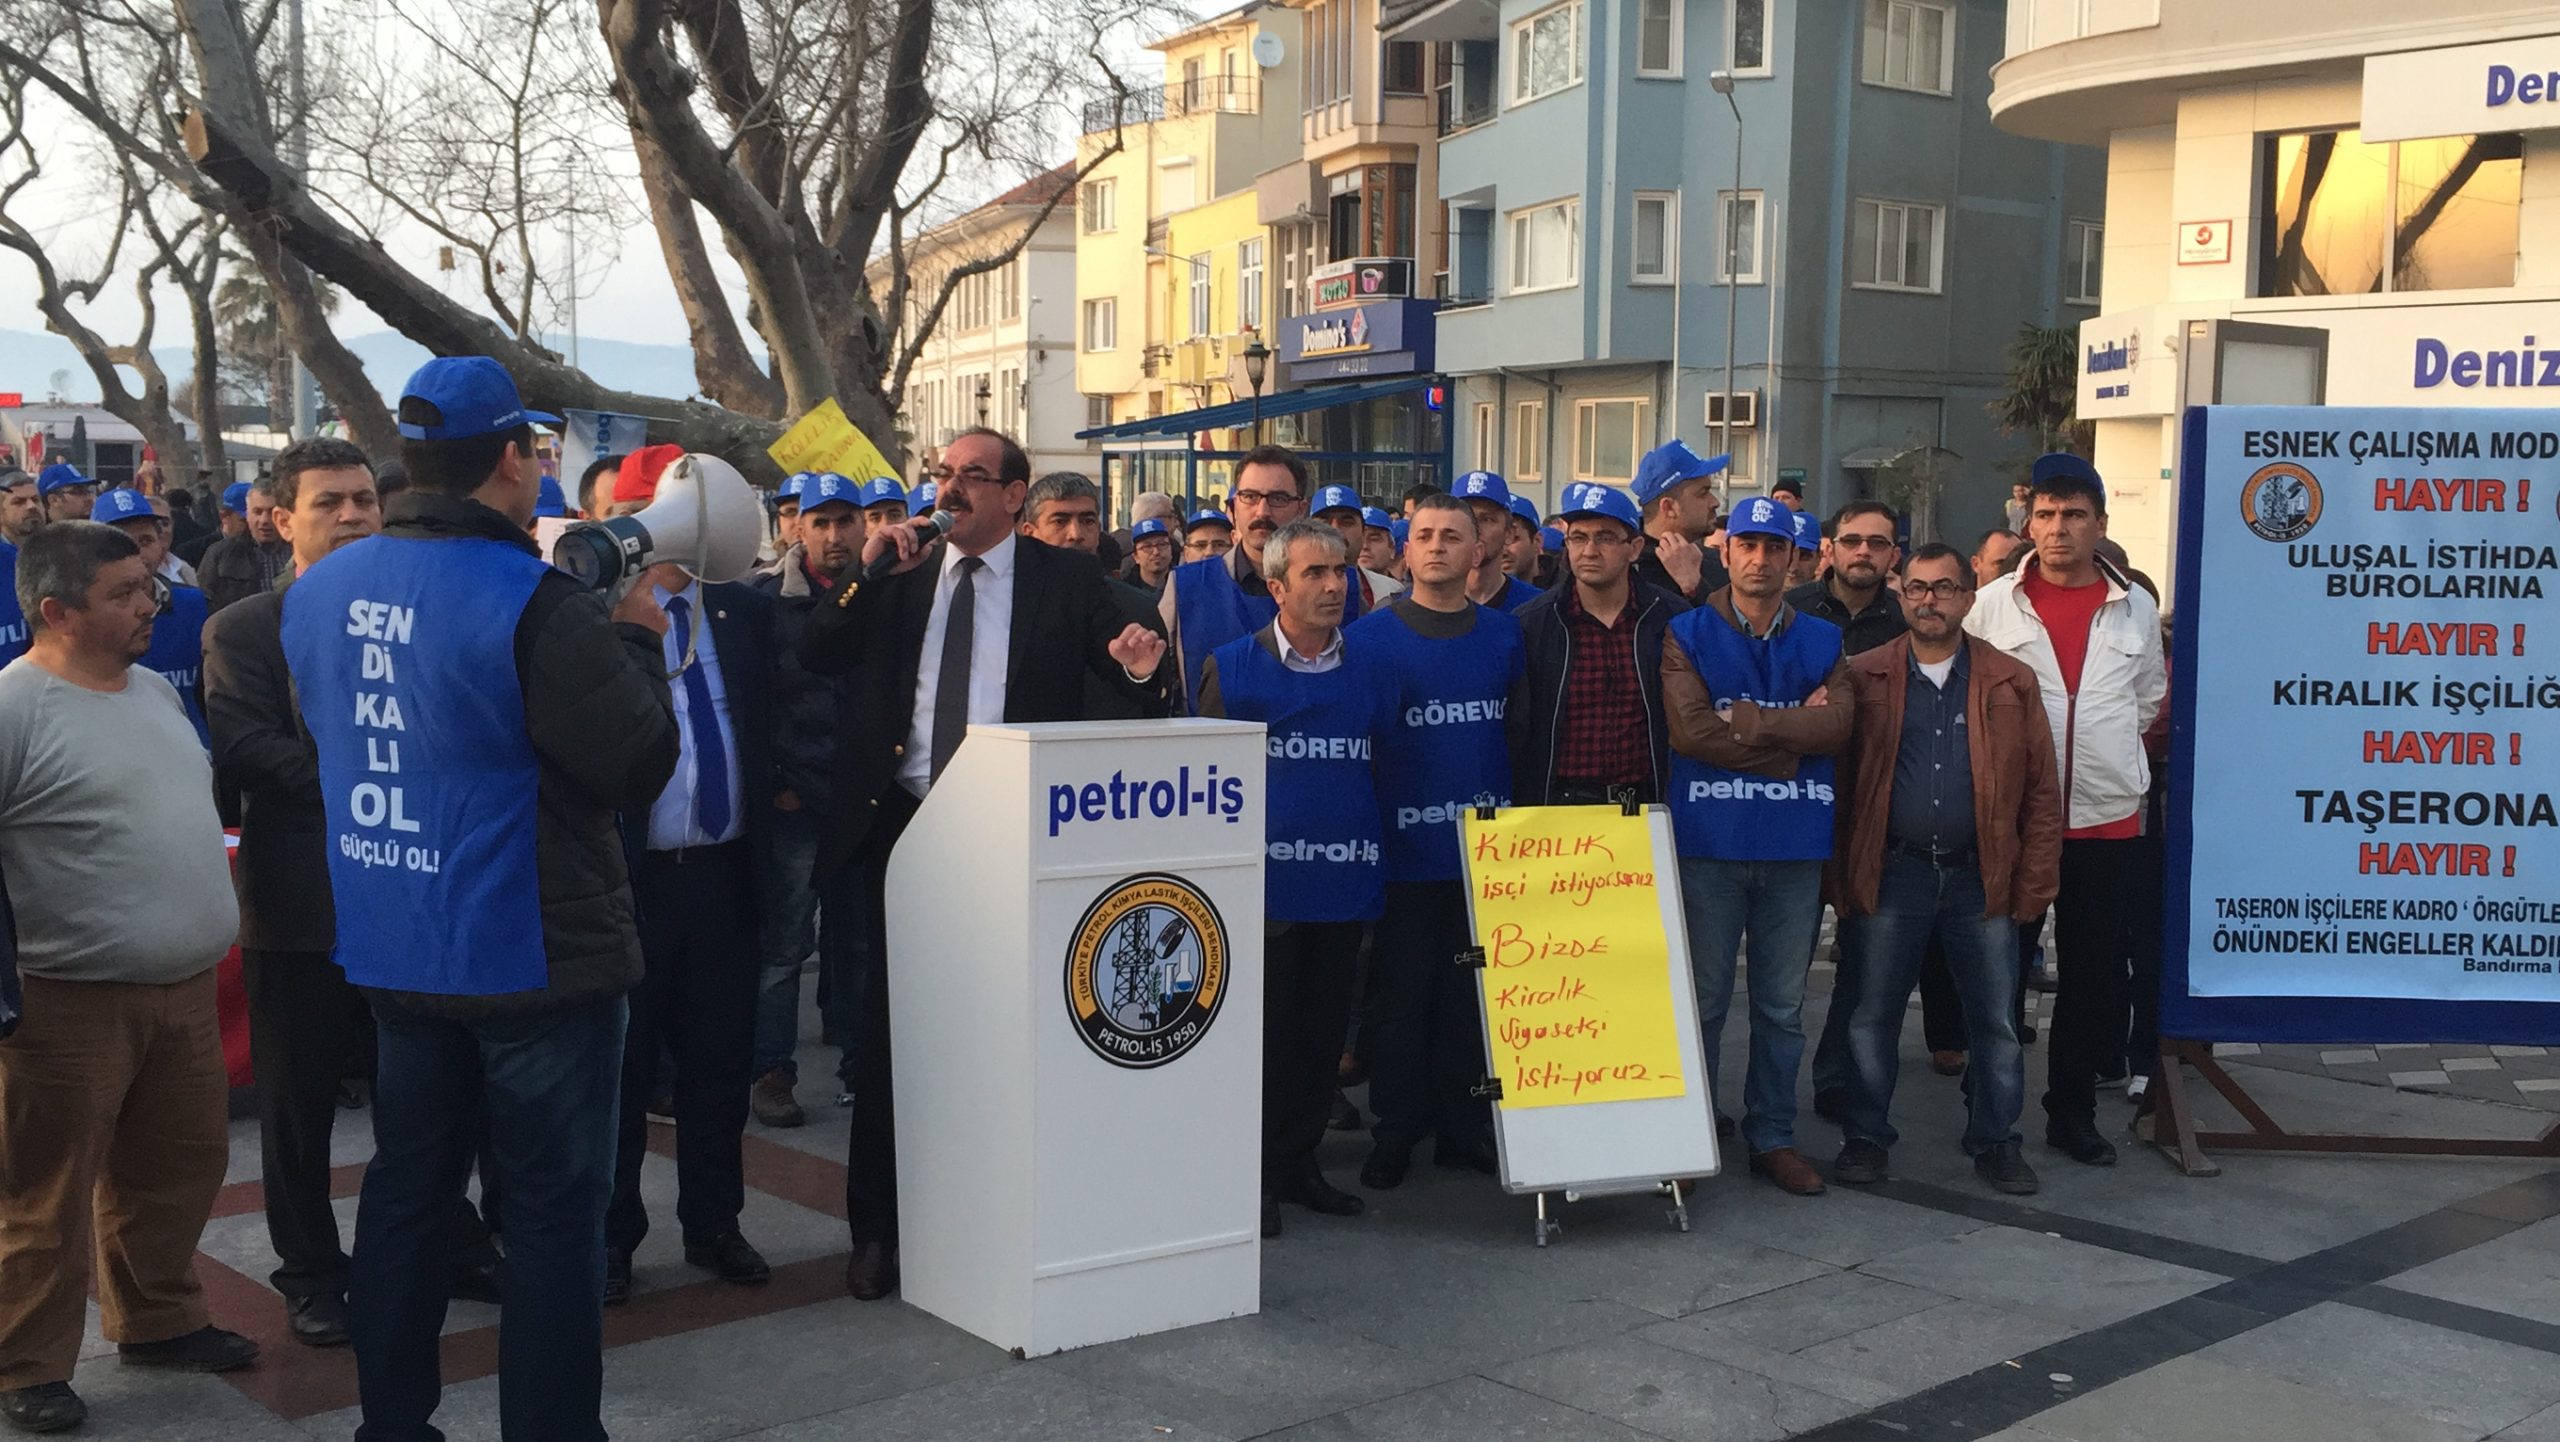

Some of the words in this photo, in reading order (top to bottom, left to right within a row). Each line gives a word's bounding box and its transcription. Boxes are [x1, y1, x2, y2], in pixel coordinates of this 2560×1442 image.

[2414, 335, 2560, 388] Deniz
[2244, 430, 2341, 458] ESNEK
[2349, 431, 2479, 465] ÇALIŞMA
[2490, 431, 2560, 459] MOD
[2375, 479, 2507, 511] HAYIR
[2517, 479, 2530, 512] !
[2288, 543, 2417, 573] ULUŞAL
[2428, 539, 2558, 569] İSTİHDA
[2326, 569, 2544, 599] BÜROLARINA
[346, 599, 414, 644] SEN
[2368, 622, 2498, 656] HAYIR
[2512, 624, 2526, 656] !
[361, 643, 395, 684] Dİ
[2273, 673, 2419, 706] KİRALIK
[2432, 674, 2560, 715] İŞÇİLİĞ
[354, 691, 405, 732] KA
[367, 737, 400, 773] LI
[2363, 731, 2494, 765] HAYIR
[2509, 732, 2522, 765] !
[350, 782, 420, 833] OL
[1049, 765, 1244, 837] petrol-iş
[1689, 778, 1834, 806] petrol-iş
[2296, 790, 2559, 833] TAŞERONA
[340, 832, 400, 868] GÜÇLÜ
[405, 846, 440, 874] OL!
[1265, 839, 1379, 866] etrol-iş
[2359, 843, 2490, 876] HAYIR
[2503, 845, 2517, 877] !
[2215, 898, 2299, 924] TAŞERON
[2305, 893, 2387, 925] İŞÇİLERE
[2393, 900, 2457, 921] KADRO
[1076, 952, 1091, 1001] TÜRKİYE
[1085, 909, 1113, 949] PETROL
[1112, 891, 1143, 910] KİMYA
[1144, 888, 1180, 900] LASTİK
[1181, 893, 1213, 930] İŞÇİLERİ
[1204, 931, 1220, 991] SENDİKASI
[2213, 925, 2338, 954] ÖNÜNDEKİ
[2346, 931, 2474, 956] ENGELLER
[2482, 933, 2560, 958] KALDI
[2463, 957, 2552, 974] Bandırma
[1098, 1027, 1163, 1056] PETROL-İŞ
[1166, 1022, 1197, 1045] 1950
